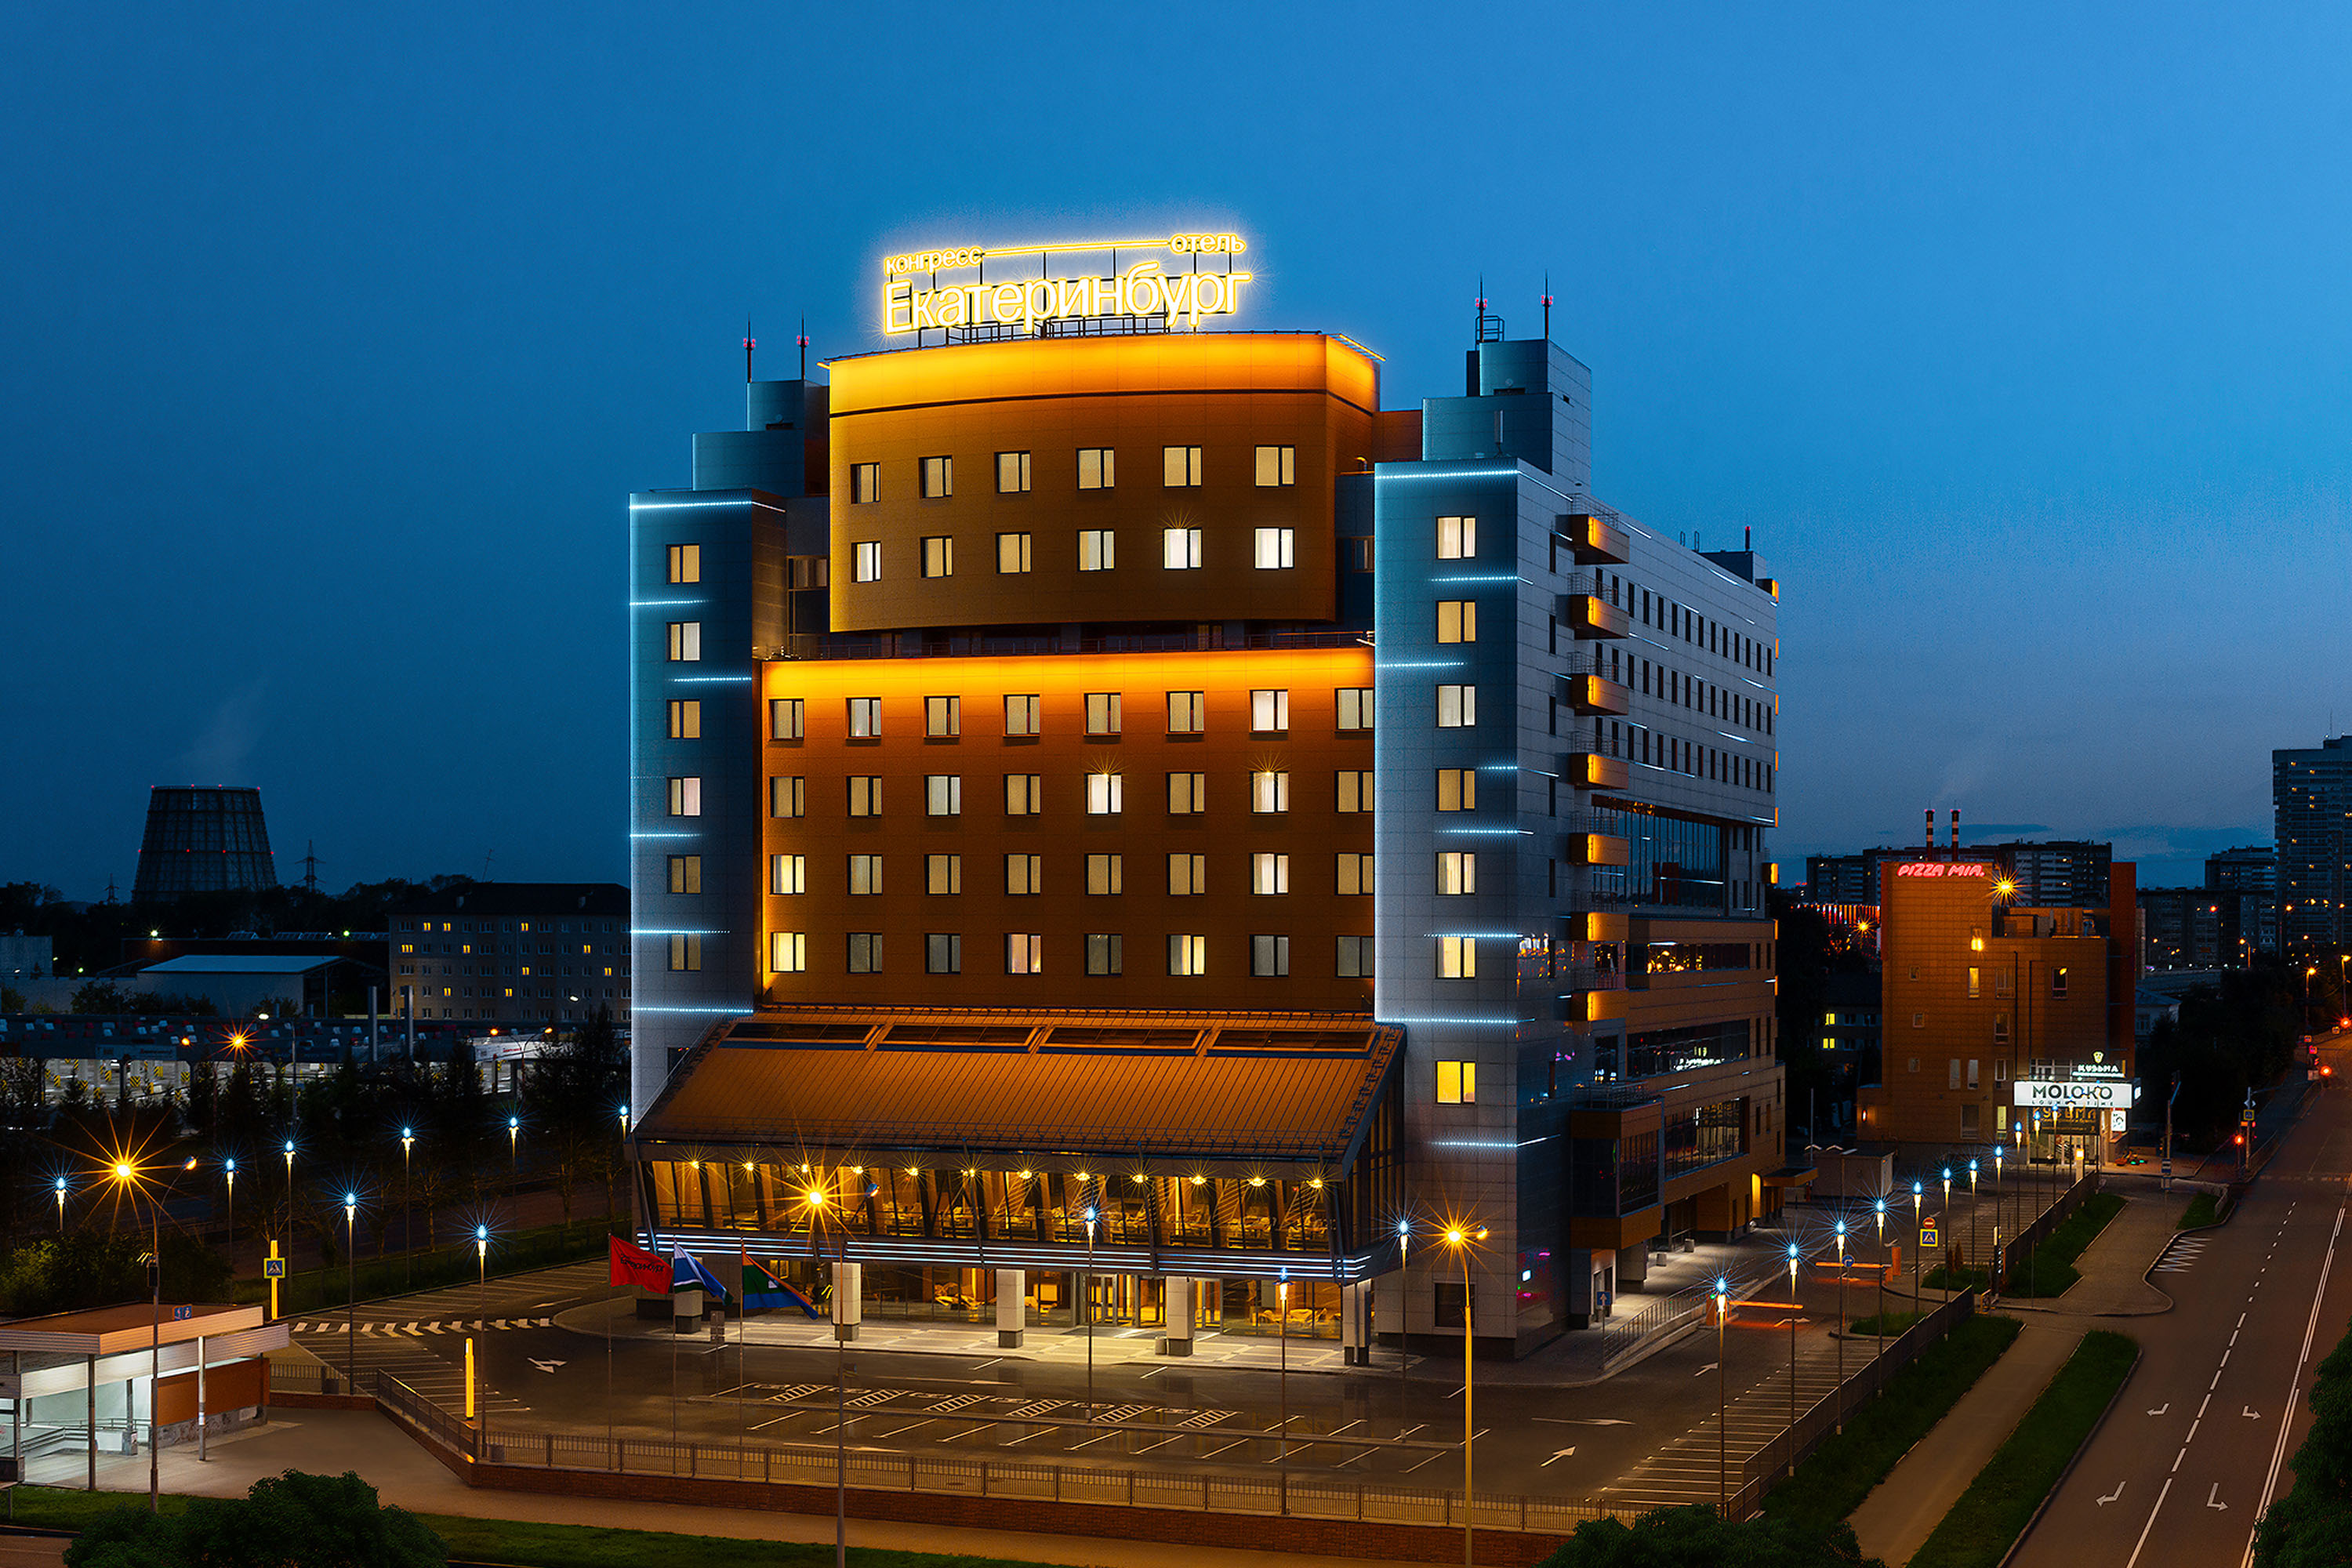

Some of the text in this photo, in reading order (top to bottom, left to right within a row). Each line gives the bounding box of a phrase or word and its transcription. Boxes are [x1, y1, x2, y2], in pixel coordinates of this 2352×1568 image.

[884, 234, 1247, 274] конгресс отель
[884, 262, 1252, 334] Екатеринбург
[1897, 862, 1945, 877] PIZZA
[2032, 1084, 2113, 1099] MOLOKO
